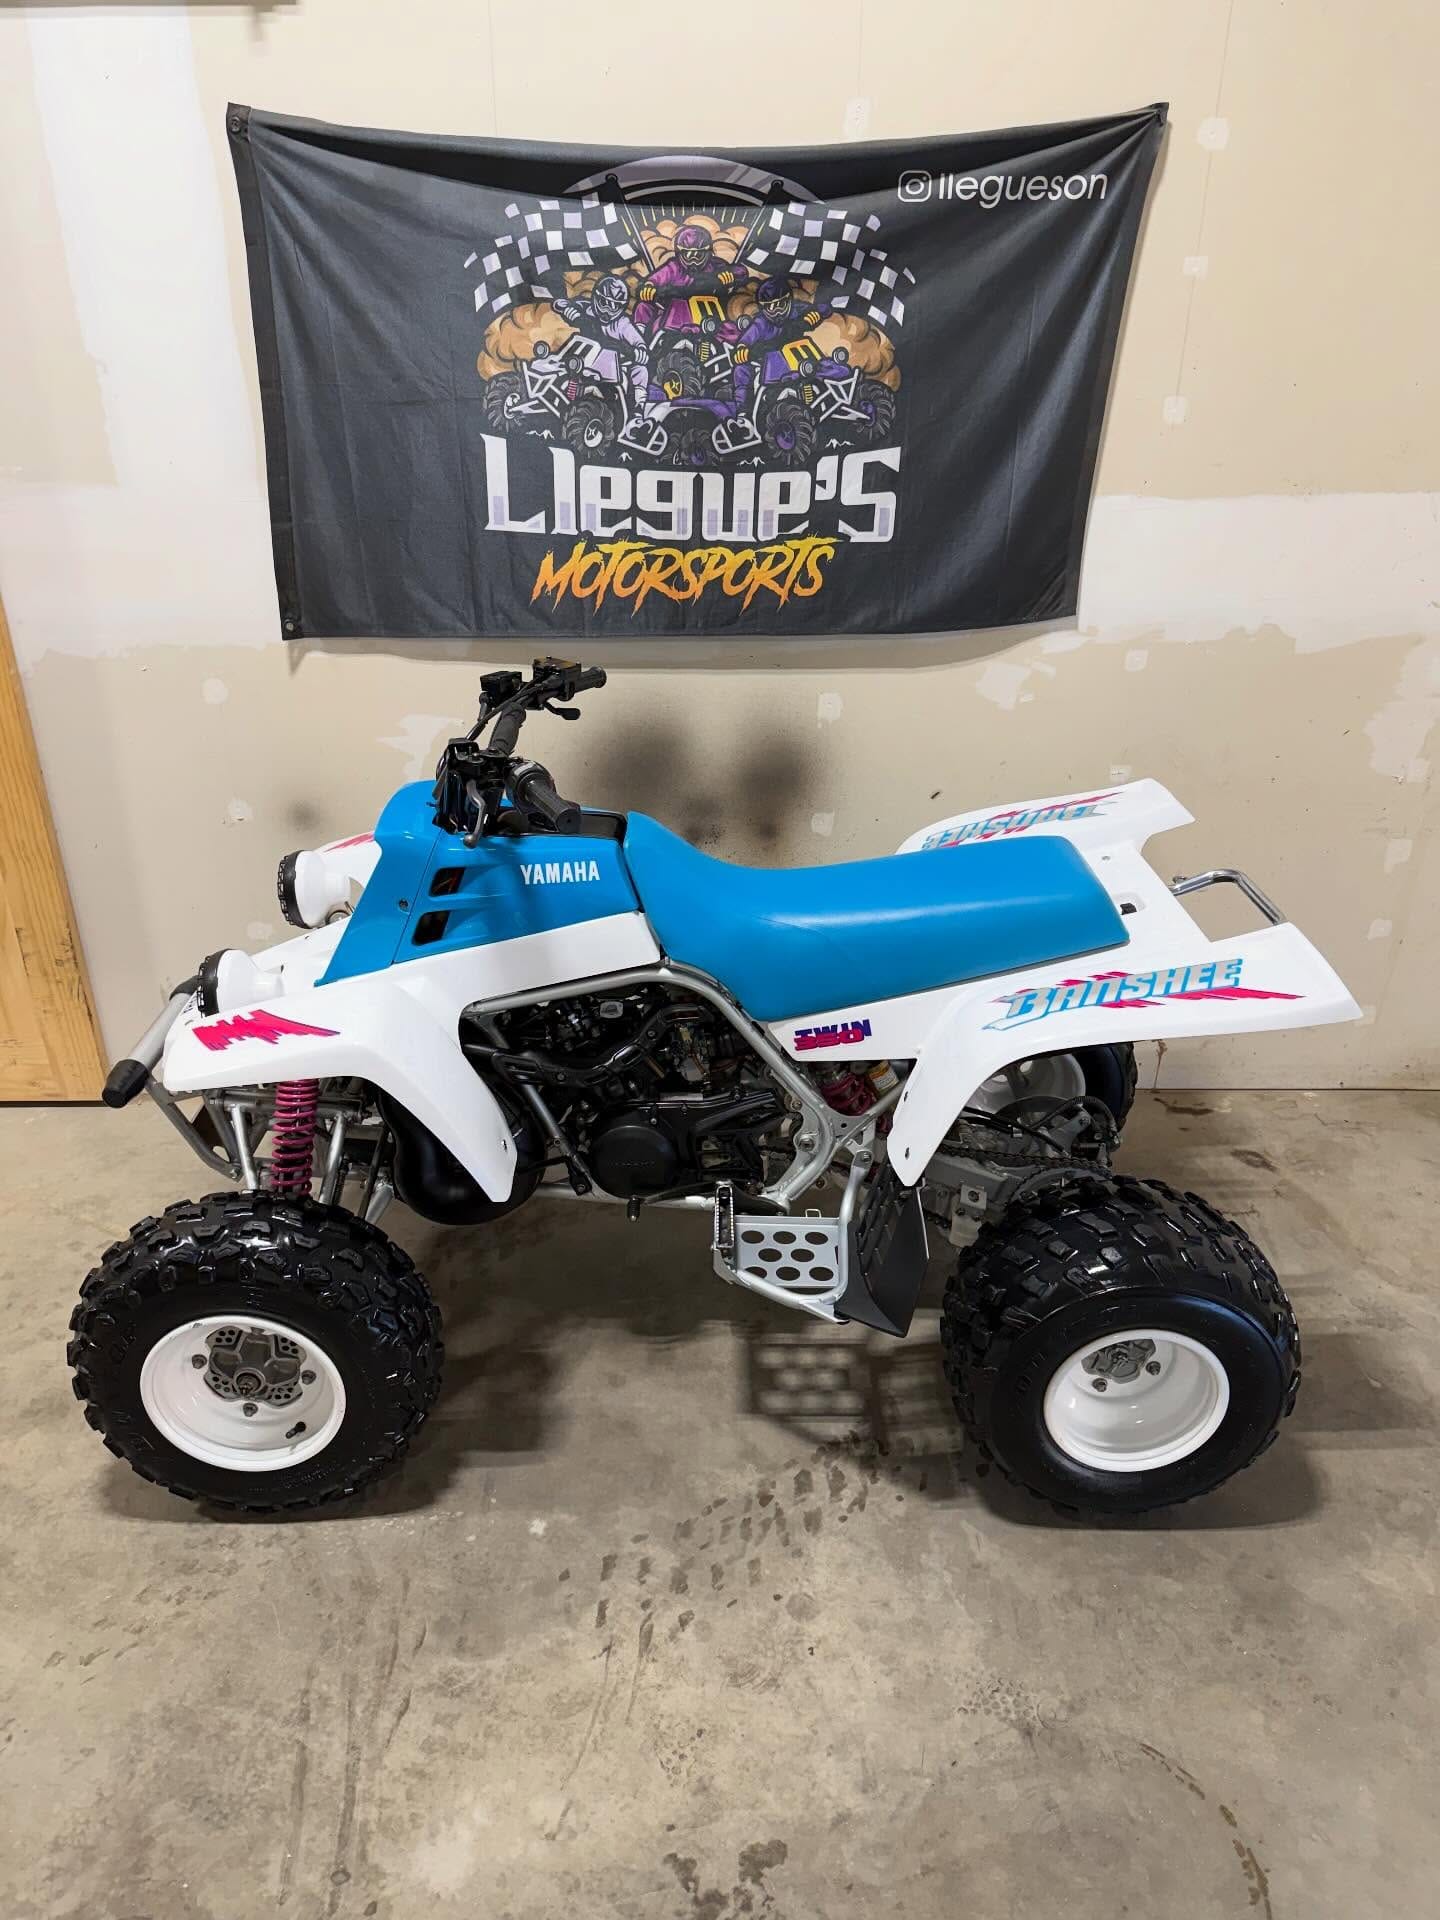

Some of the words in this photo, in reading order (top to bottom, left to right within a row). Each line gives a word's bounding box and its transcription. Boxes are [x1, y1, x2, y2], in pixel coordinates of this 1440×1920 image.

[938, 173, 1108, 209] llegueson
[529, 533, 843, 618] MOTORSPORTS
[519, 860, 601, 885] YAMAHA
[981, 958, 1244, 1031] BANSHEE
